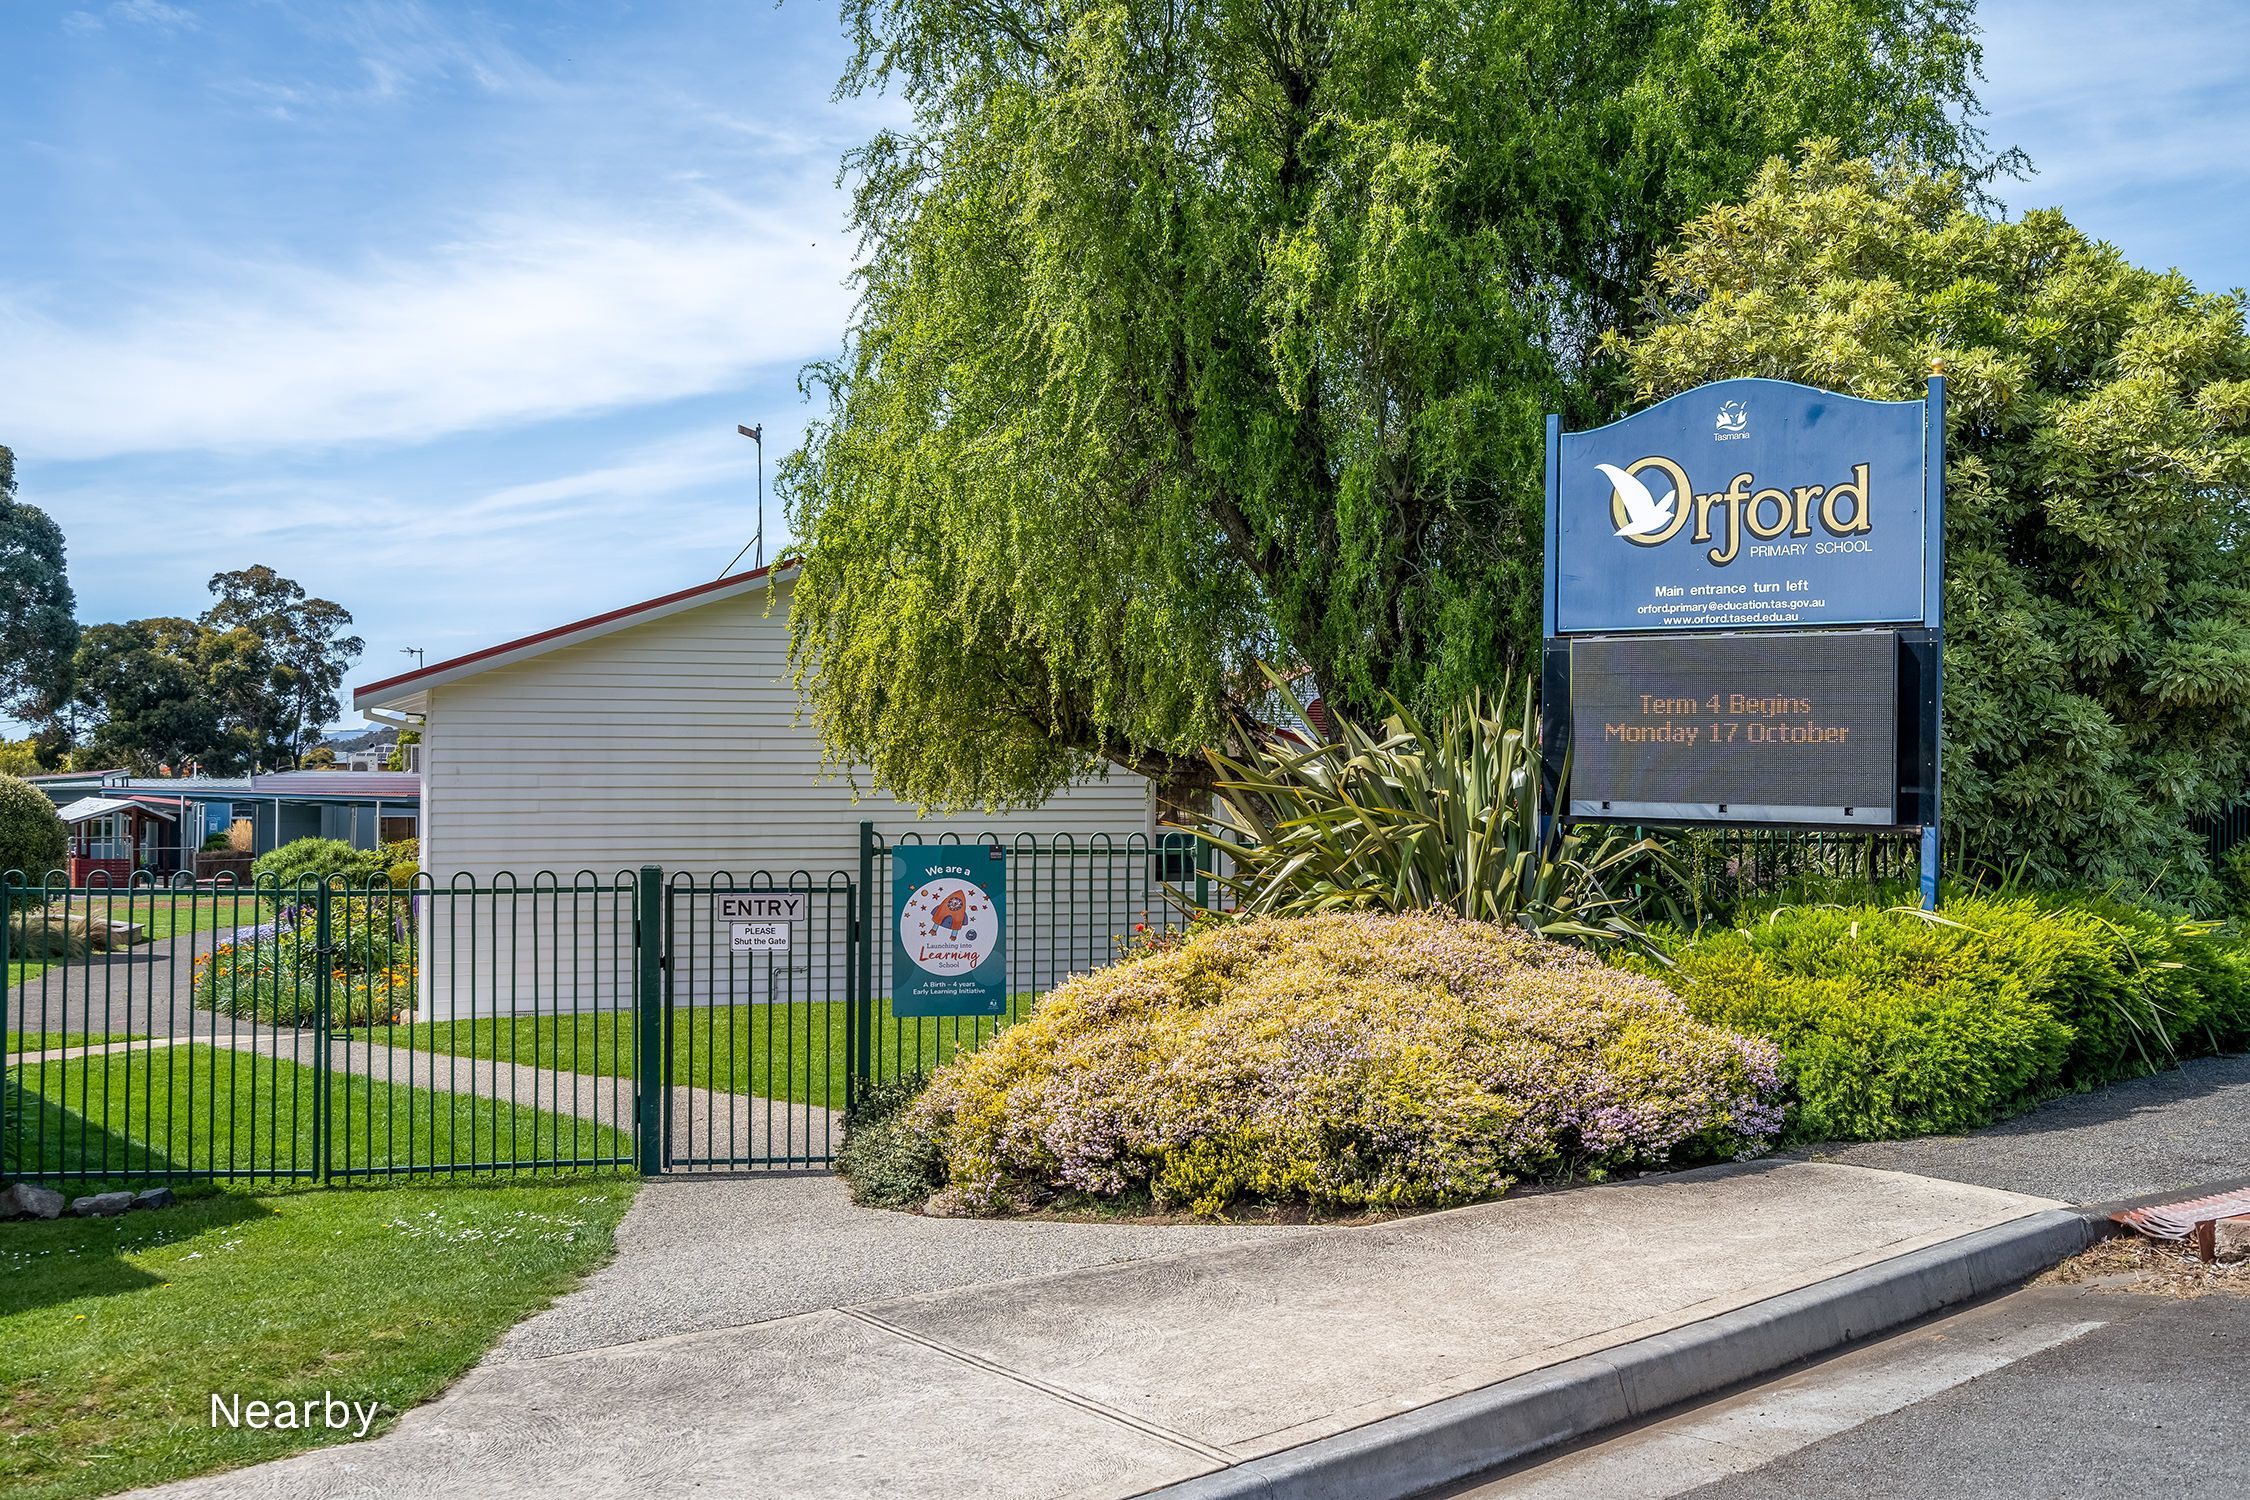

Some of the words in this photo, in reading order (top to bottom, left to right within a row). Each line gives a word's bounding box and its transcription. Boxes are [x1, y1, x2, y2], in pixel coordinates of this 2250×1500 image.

[1713, 431, 1750, 442] Tasmania
[1610, 455, 1872, 567] Orford
[1750, 543, 1808, 557] PRIMARY
[1815, 540, 1873, 554] SCHOOL
[1655, 585, 1684, 597] Main
[1690, 583, 1747, 595] entrance
[1754, 581, 1780, 593] turn
[1786, 579, 1809, 592] left
[1637, 599, 1825, 614] orford.primary@education.tas.gov.au
[1663, 613, 1799, 625] www.orford.tased.edu.au
[1640, 694, 1697, 714] Term
[1706, 694, 1720, 714] 4
[1730, 694, 1811, 718] Begins
[1605, 721, 1699, 747] Monday
[1709, 723, 1738, 742] 17
[1747, 721, 1849, 743] October
[925, 866, 943, 877] We
[945, 866, 962, 874] are
[964, 869, 971, 877] a
[723, 900, 798, 916] ENTRY
[926, 942, 959, 950] Launching
[919, 946, 980, 968] Learning
